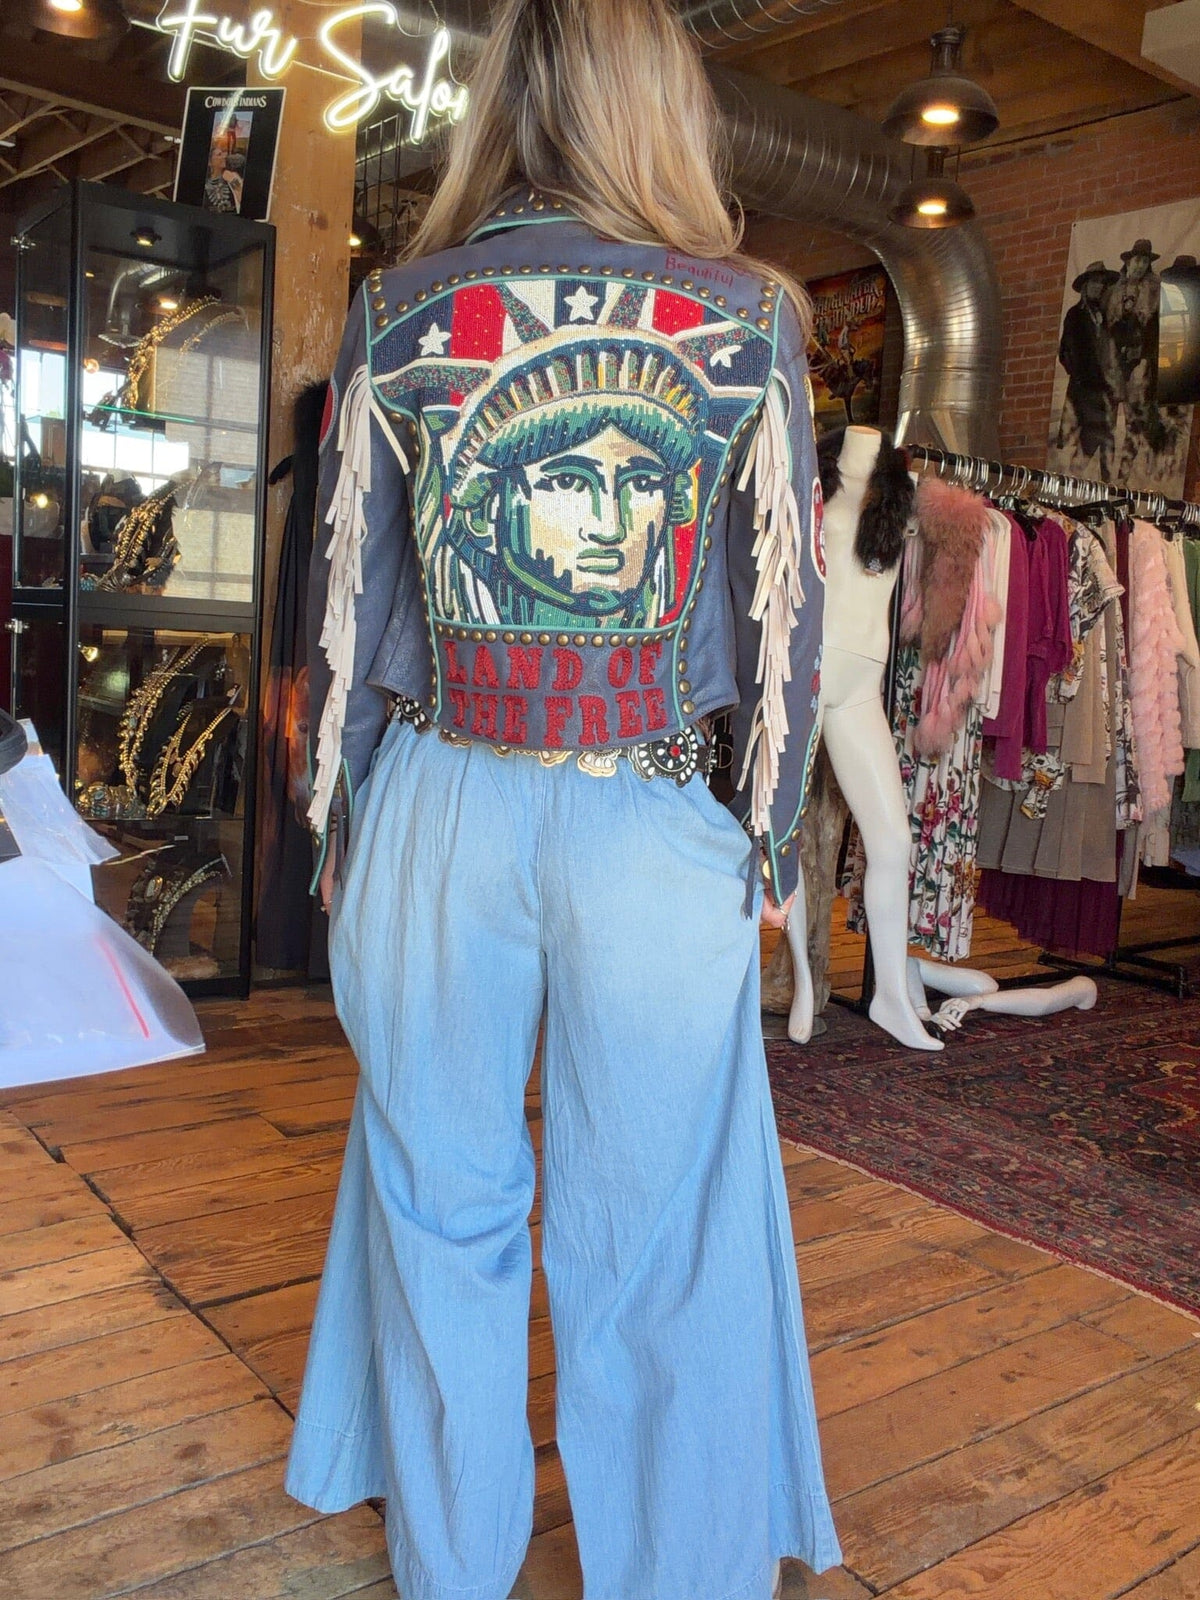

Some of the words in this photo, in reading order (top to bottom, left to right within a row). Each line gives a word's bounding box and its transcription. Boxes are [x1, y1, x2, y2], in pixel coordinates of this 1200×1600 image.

[444, 640, 584, 692] LAND
[607, 641, 663, 689] OF
[448, 687, 529, 744] THE
[543, 686, 669, 749] FREE
